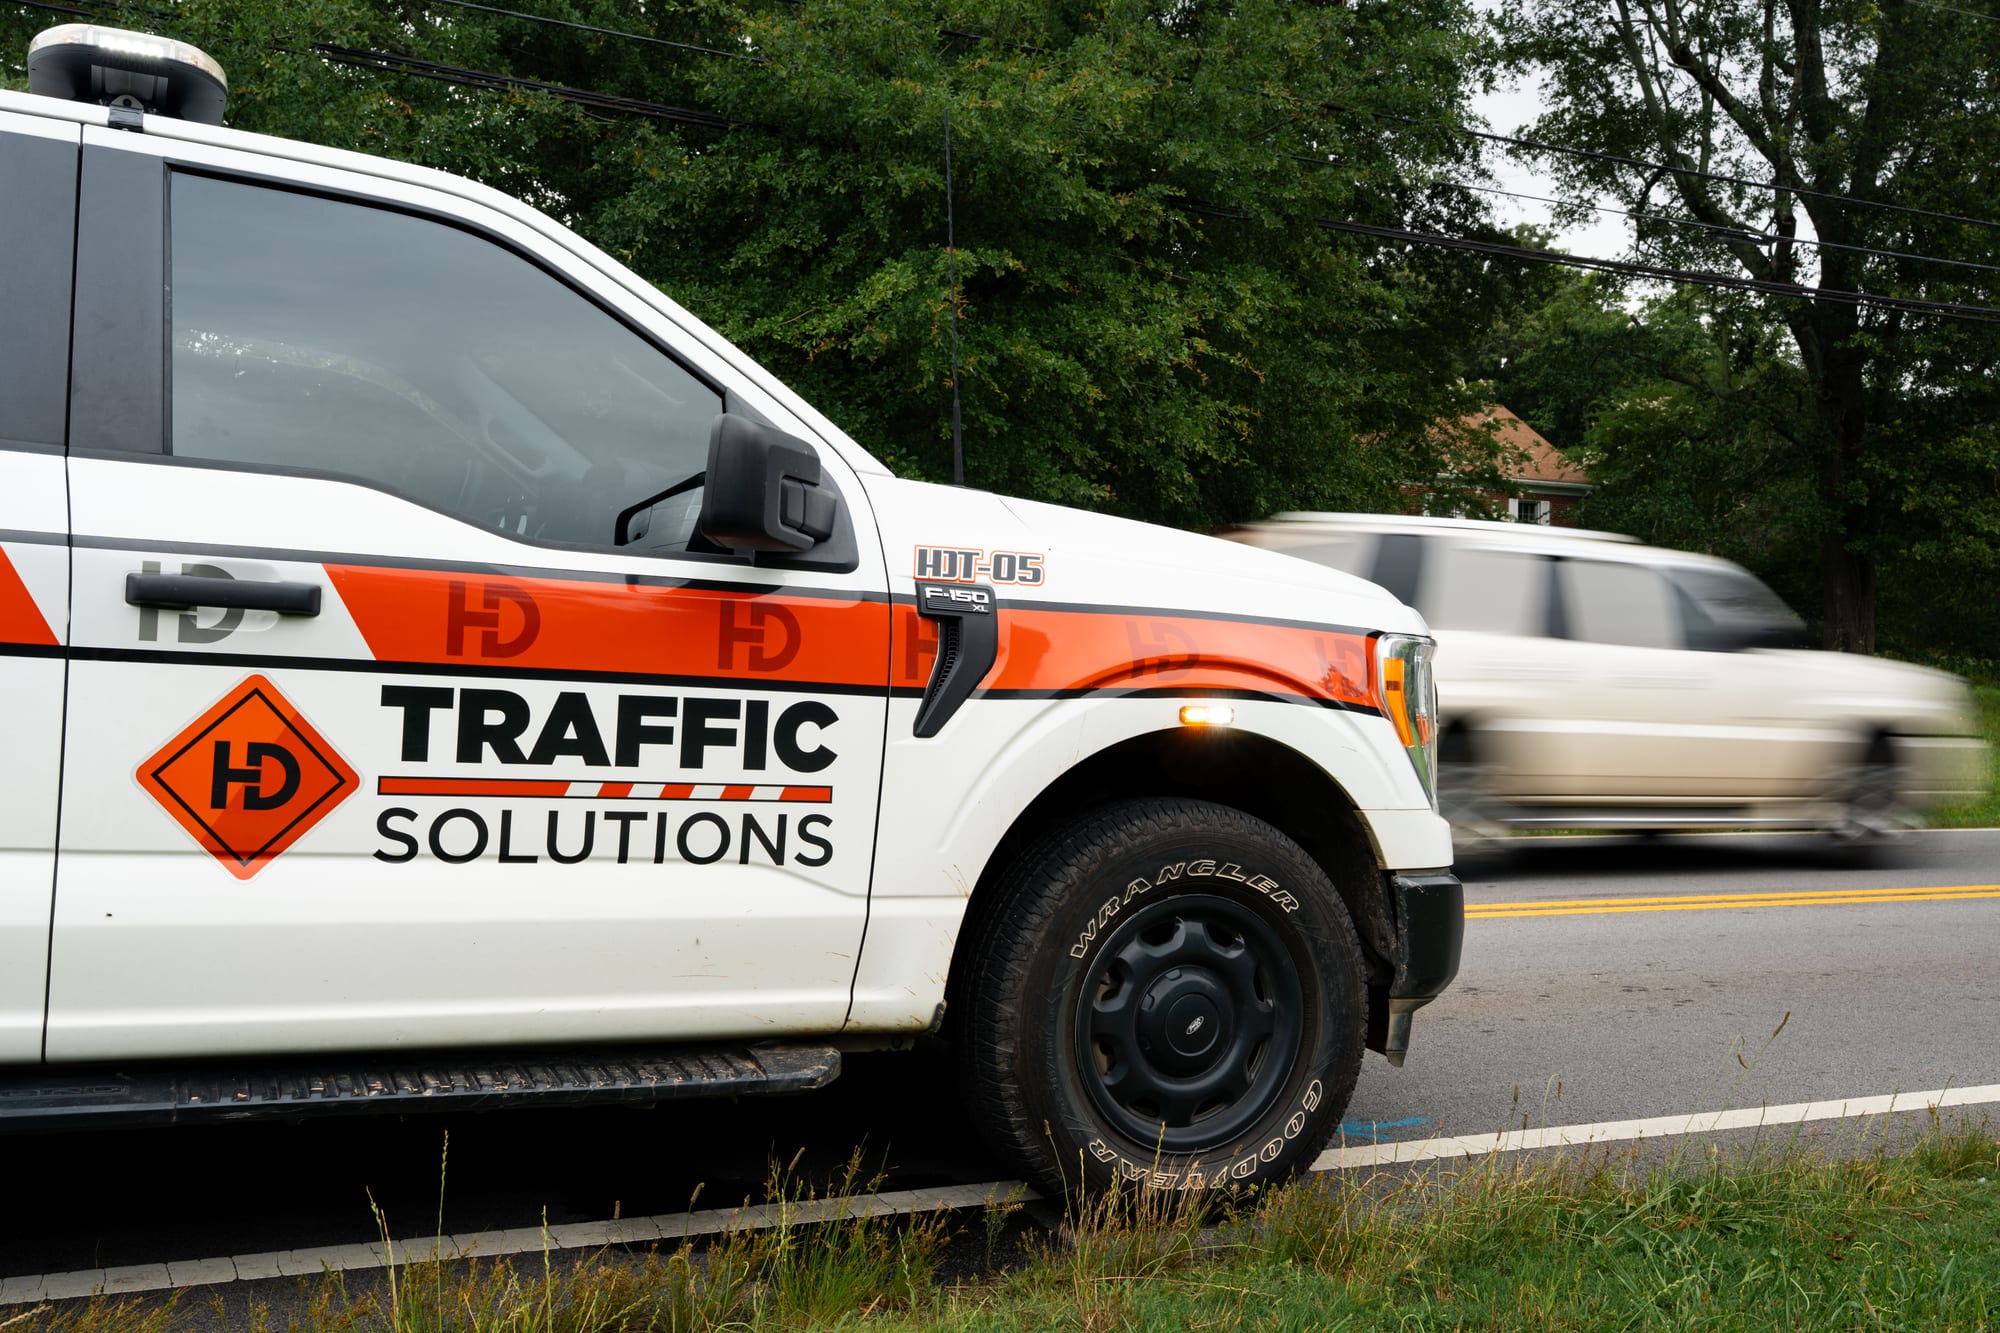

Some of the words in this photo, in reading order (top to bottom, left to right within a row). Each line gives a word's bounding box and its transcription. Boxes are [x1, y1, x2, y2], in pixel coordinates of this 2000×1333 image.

[915, 546, 1044, 586] HDT-05
[924, 587, 990, 604] F-150
[446, 580, 541, 658] HD
[717, 599, 802, 672] HD
[972, 604, 989, 612] XL
[381, 685, 839, 773] TRAFFIC
[210, 740, 301, 811] HD
[373, 807, 834, 867] SOLUTIONS
[1069, 859, 1300, 960] WRANGLER
[1089, 1079, 1324, 1191] GOODYEAR
